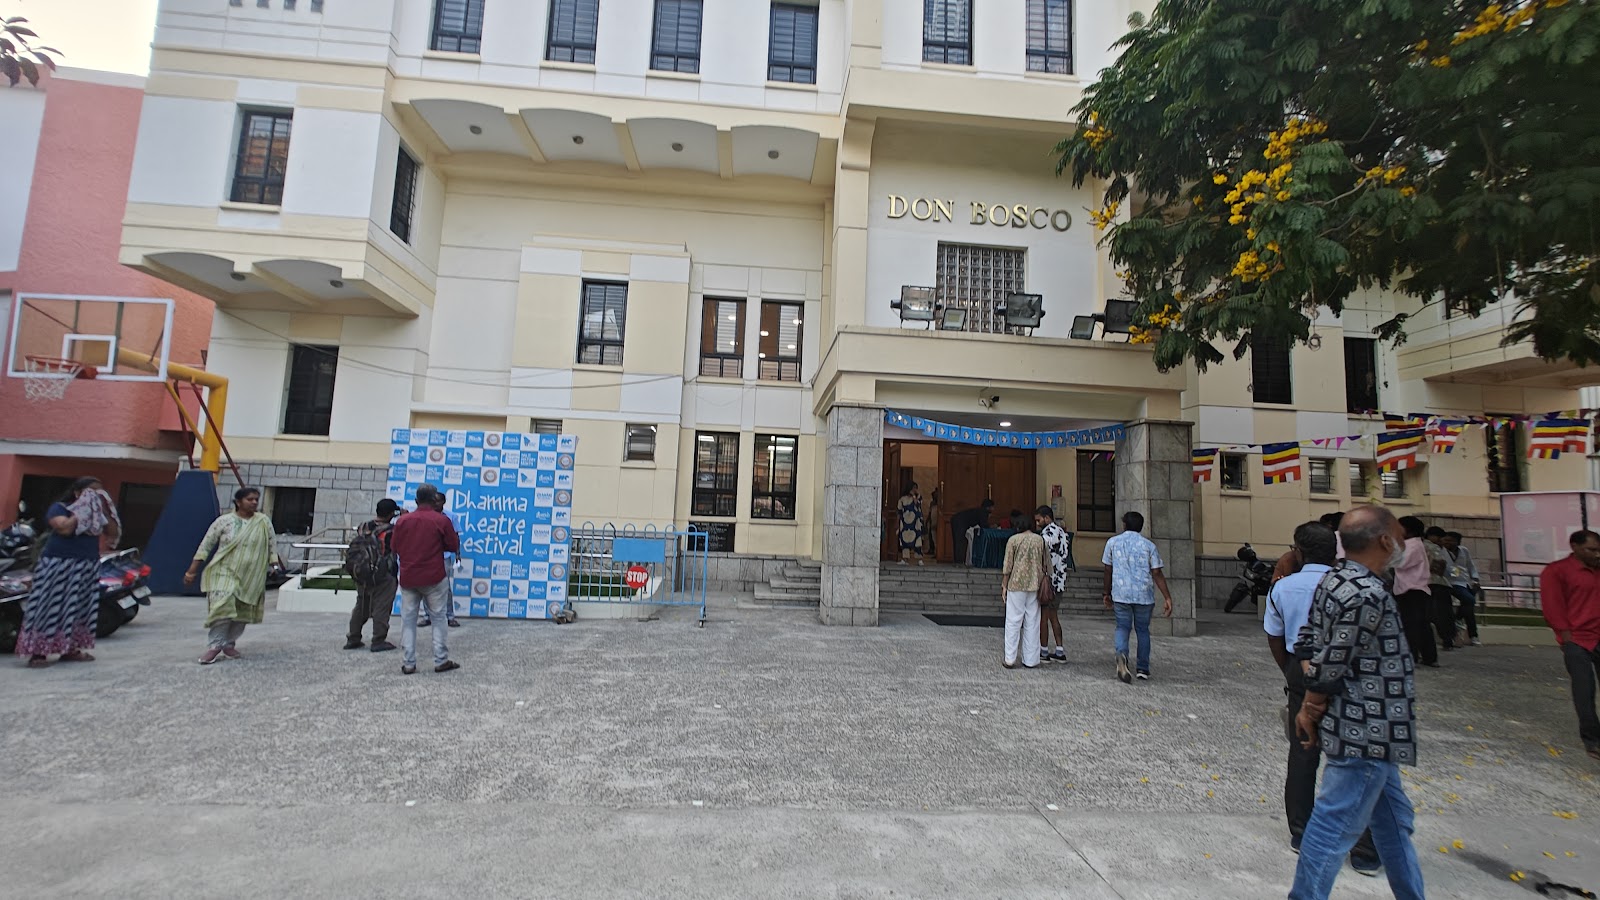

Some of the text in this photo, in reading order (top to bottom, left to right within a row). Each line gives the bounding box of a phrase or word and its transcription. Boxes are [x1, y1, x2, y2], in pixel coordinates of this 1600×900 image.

[887, 194, 1072, 232] DON BOSCO
[455, 489, 528, 513] Dhamma
[457, 511, 526, 536] Theatre
[460, 534, 525, 557] estival
[626, 571, 648, 583] STOP
